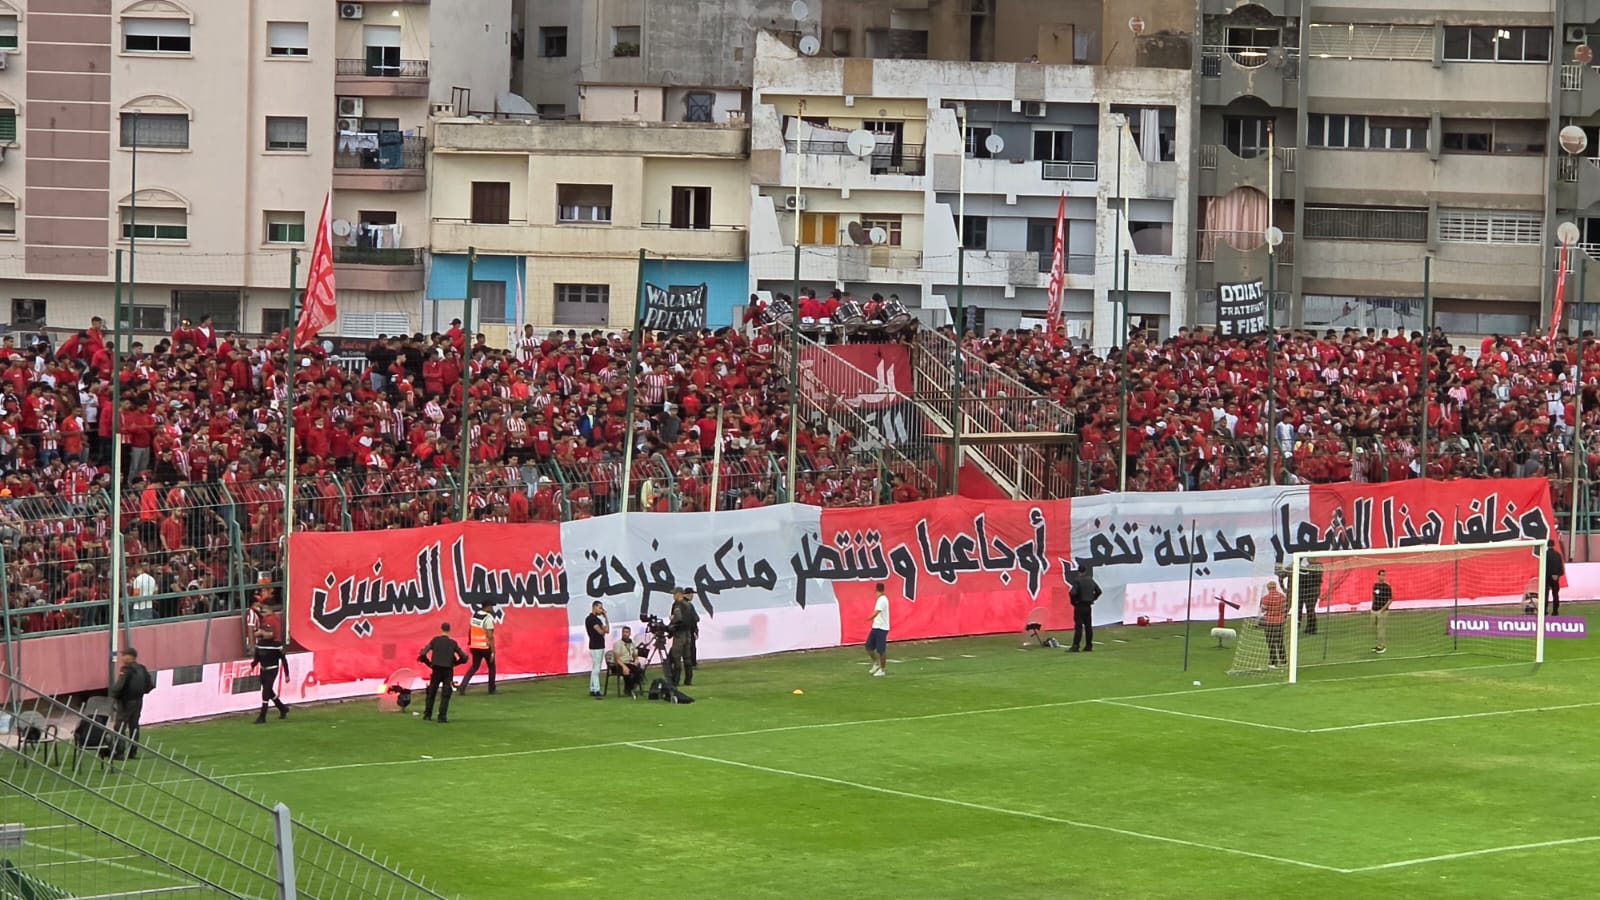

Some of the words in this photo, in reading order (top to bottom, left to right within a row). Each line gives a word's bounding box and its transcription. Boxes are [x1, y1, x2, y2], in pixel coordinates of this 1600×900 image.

[1220, 320, 1232, 335] E
[915, 507, 1050, 600] أوجاعها
[1149, 523, 1256, 577] مدينة
[1270, 497, 1374, 564] الشعار
[1381, 496, 1444, 549] هذا
[1455, 492, 1550, 559] وخلف
[310, 540, 446, 638] السنين
[451, 534, 570, 624] تنسيها
[584, 537, 677, 622] فرحة
[693, 536, 777, 618] منكم
[790, 528, 918, 610] وتنتظر
[1450, 619, 1489, 630] inwi
[1497, 620, 1537, 631] inwi
[1545, 622, 1584, 633] inwi
